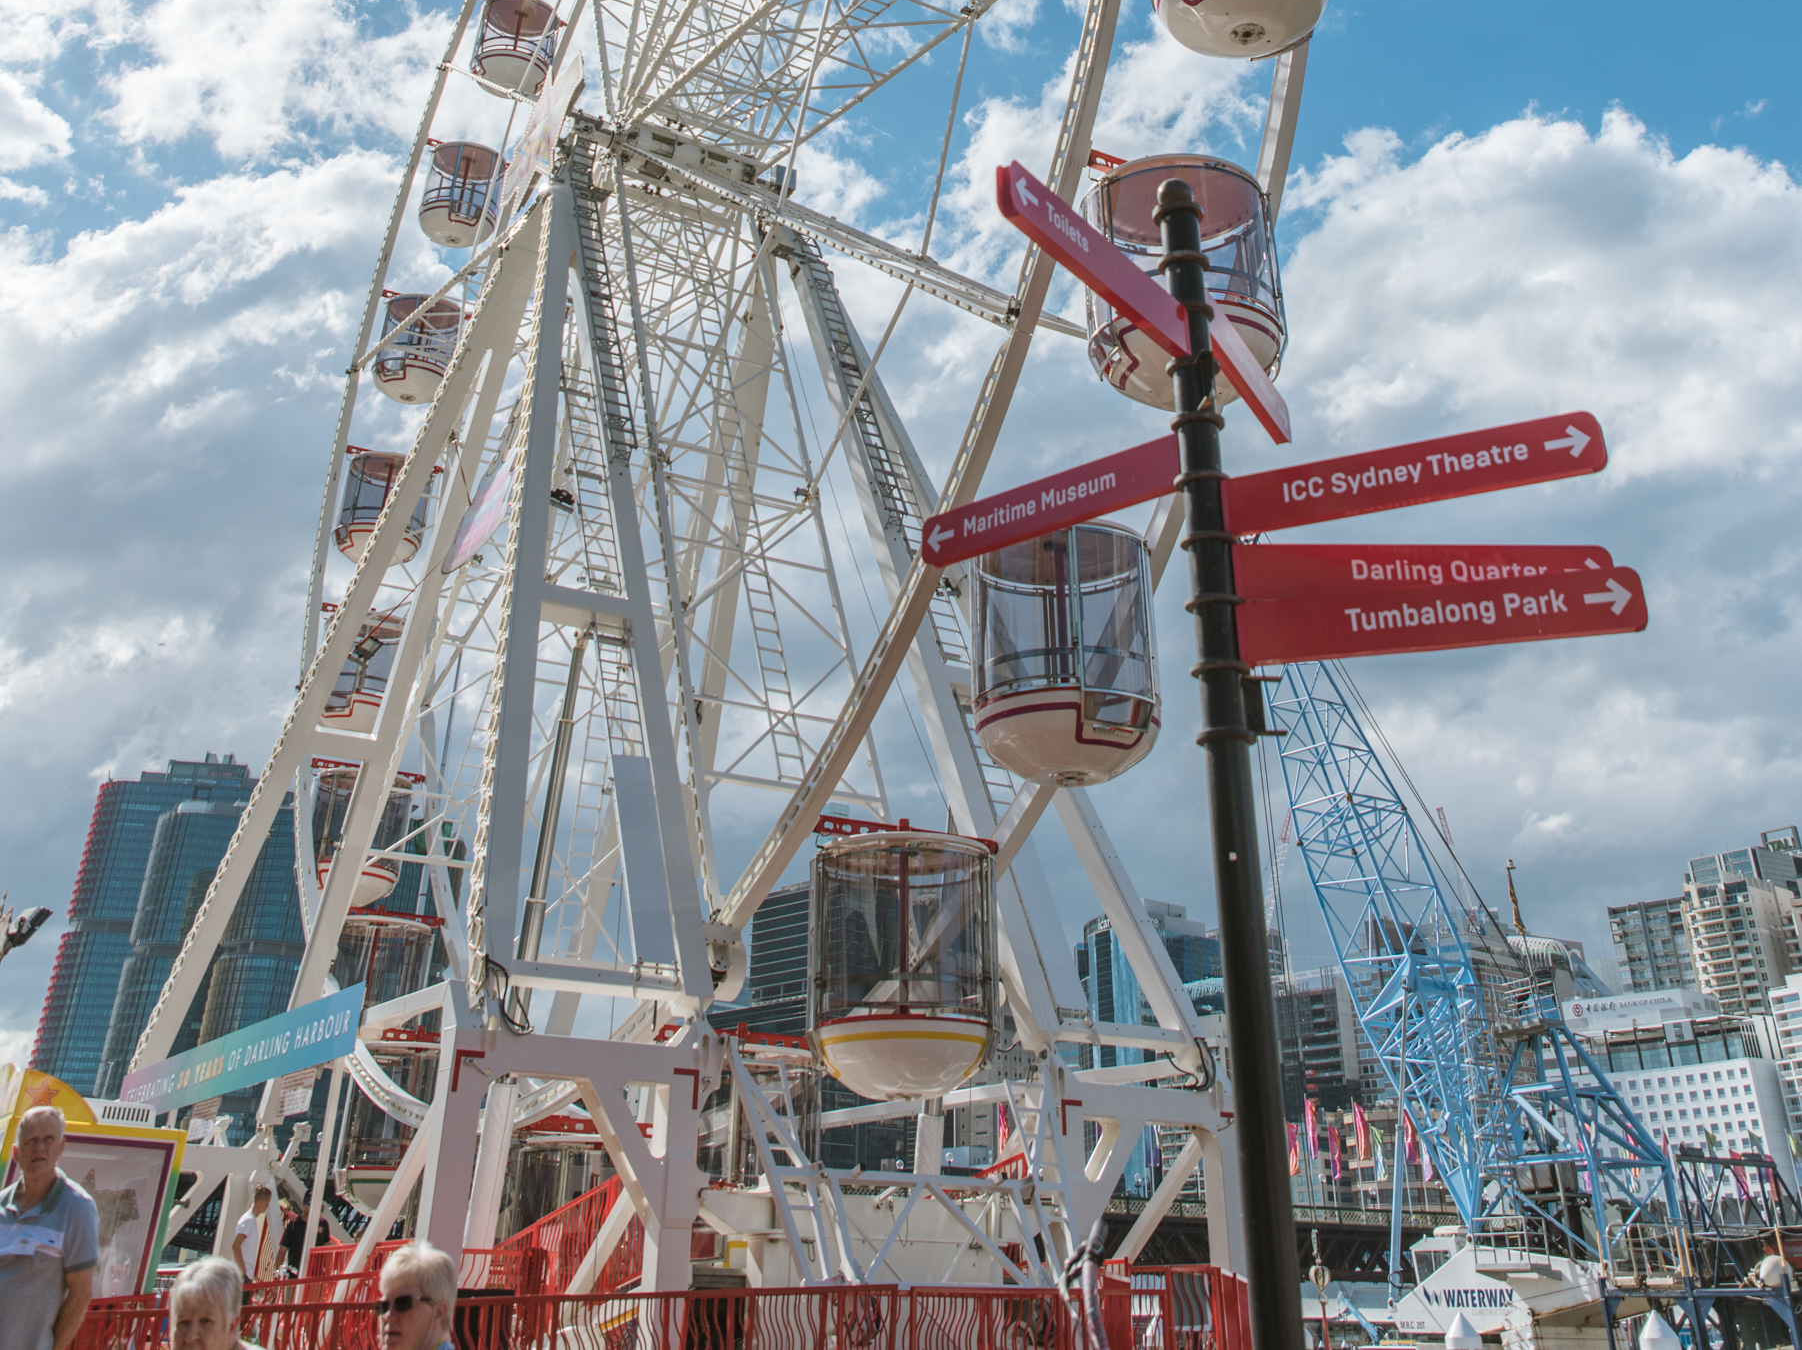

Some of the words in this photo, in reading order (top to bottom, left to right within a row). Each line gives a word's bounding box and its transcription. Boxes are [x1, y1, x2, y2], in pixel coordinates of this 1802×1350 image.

[1046, 201, 1090, 253] Toilets
[1282, 476, 1324, 503] ICC
[1331, 461, 1422, 495] Sydney
[1426, 443, 1529, 478] Theatre
[963, 499, 1037, 538] Maritime
[1041, 472, 1117, 512] Museum
[1351, 559, 1444, 585] Darling
[1344, 599, 1497, 633] Tumbalong
[1502, 588, 1569, 618] Park
[1618, 1000, 1638, 1009] BANK
[1638, 998, 1648, 1006] OF
[1649, 996, 1673, 1005] CHINA
[126, 1073, 176, 1104] CELEBRATING
[176, 1071, 190, 1092] 30
[193, 1054, 226, 1085] YEARS
[228, 1048, 243, 1072] OF
[243, 1030, 291, 1068] DARLING
[293, 1009, 351, 1050] HARBOUR
[1443, 1288, 1514, 1308] WATERWAY
